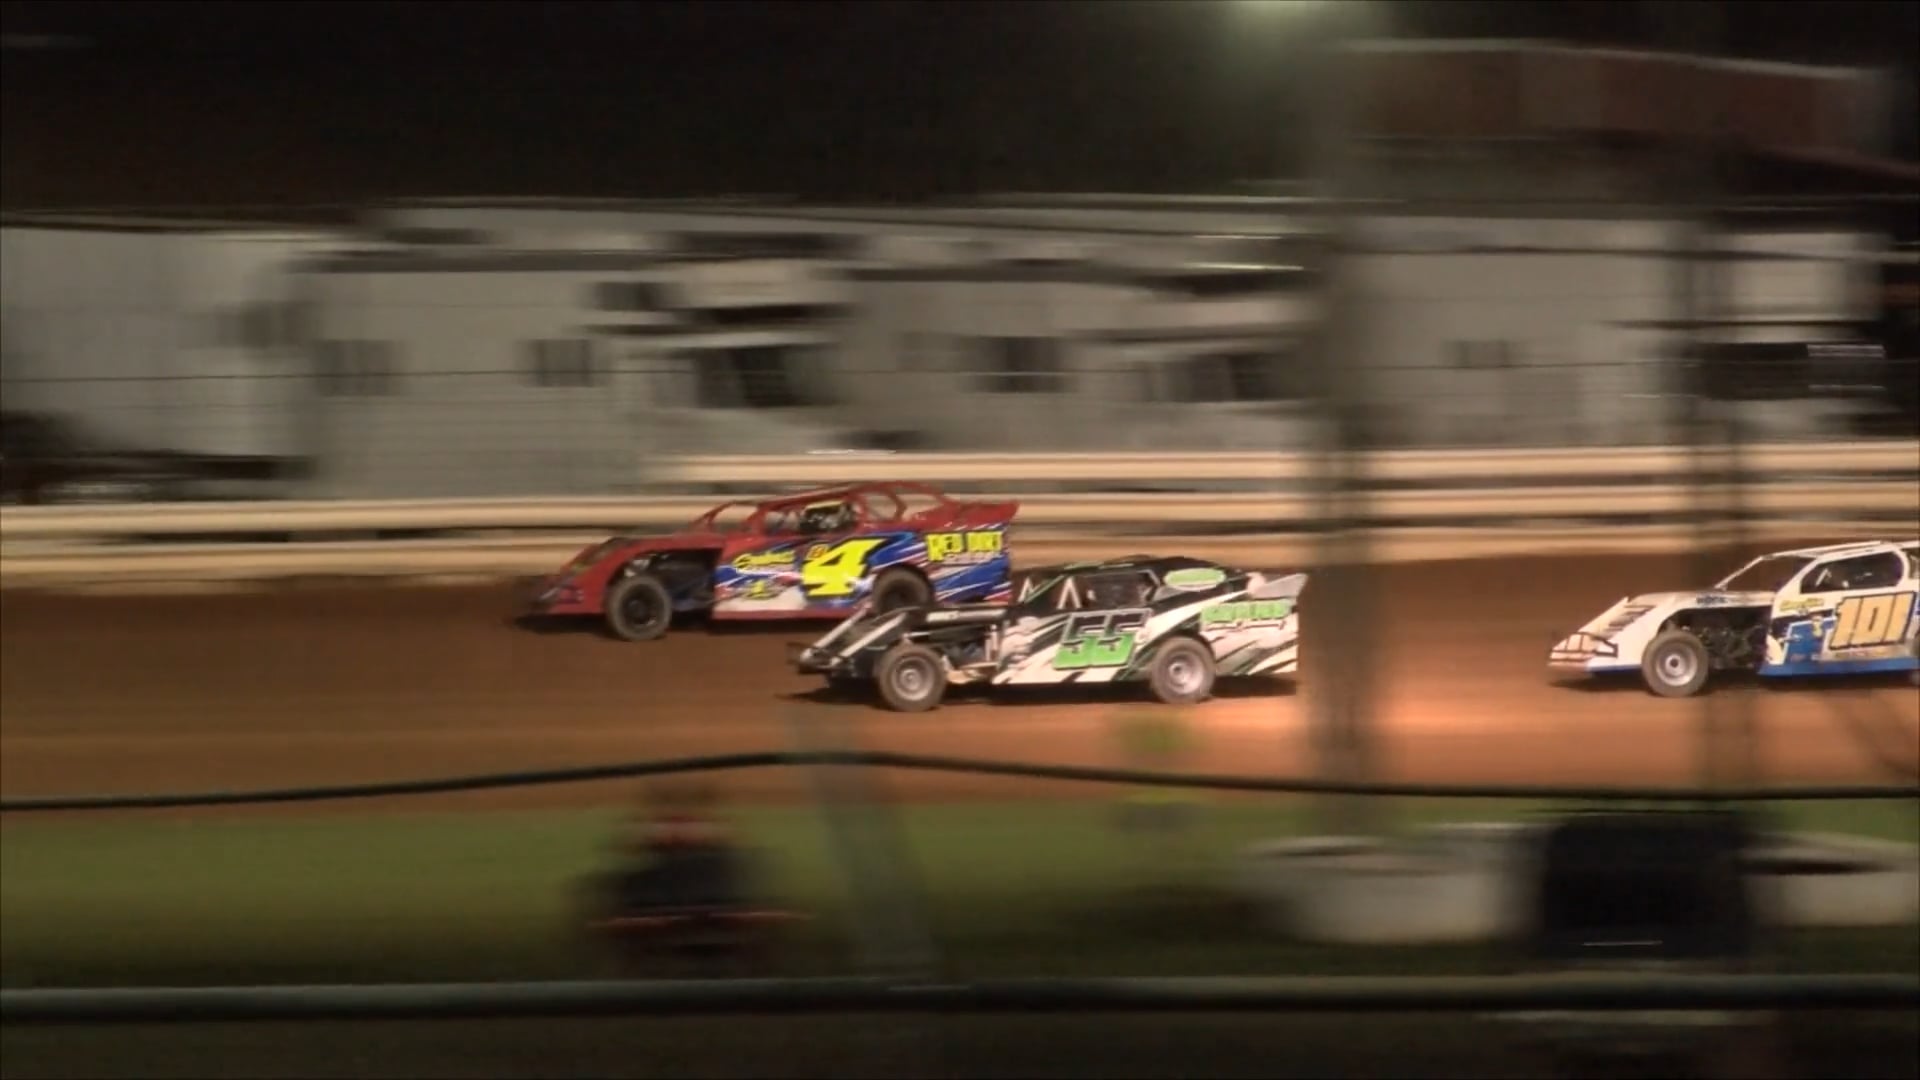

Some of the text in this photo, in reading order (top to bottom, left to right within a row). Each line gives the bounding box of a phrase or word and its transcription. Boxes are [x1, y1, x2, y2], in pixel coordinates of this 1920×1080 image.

[801, 537, 886, 597] 4
[927, 533, 963, 561] RED
[1053, 607, 1153, 670] 55
[1829, 591, 1915, 650] 101
